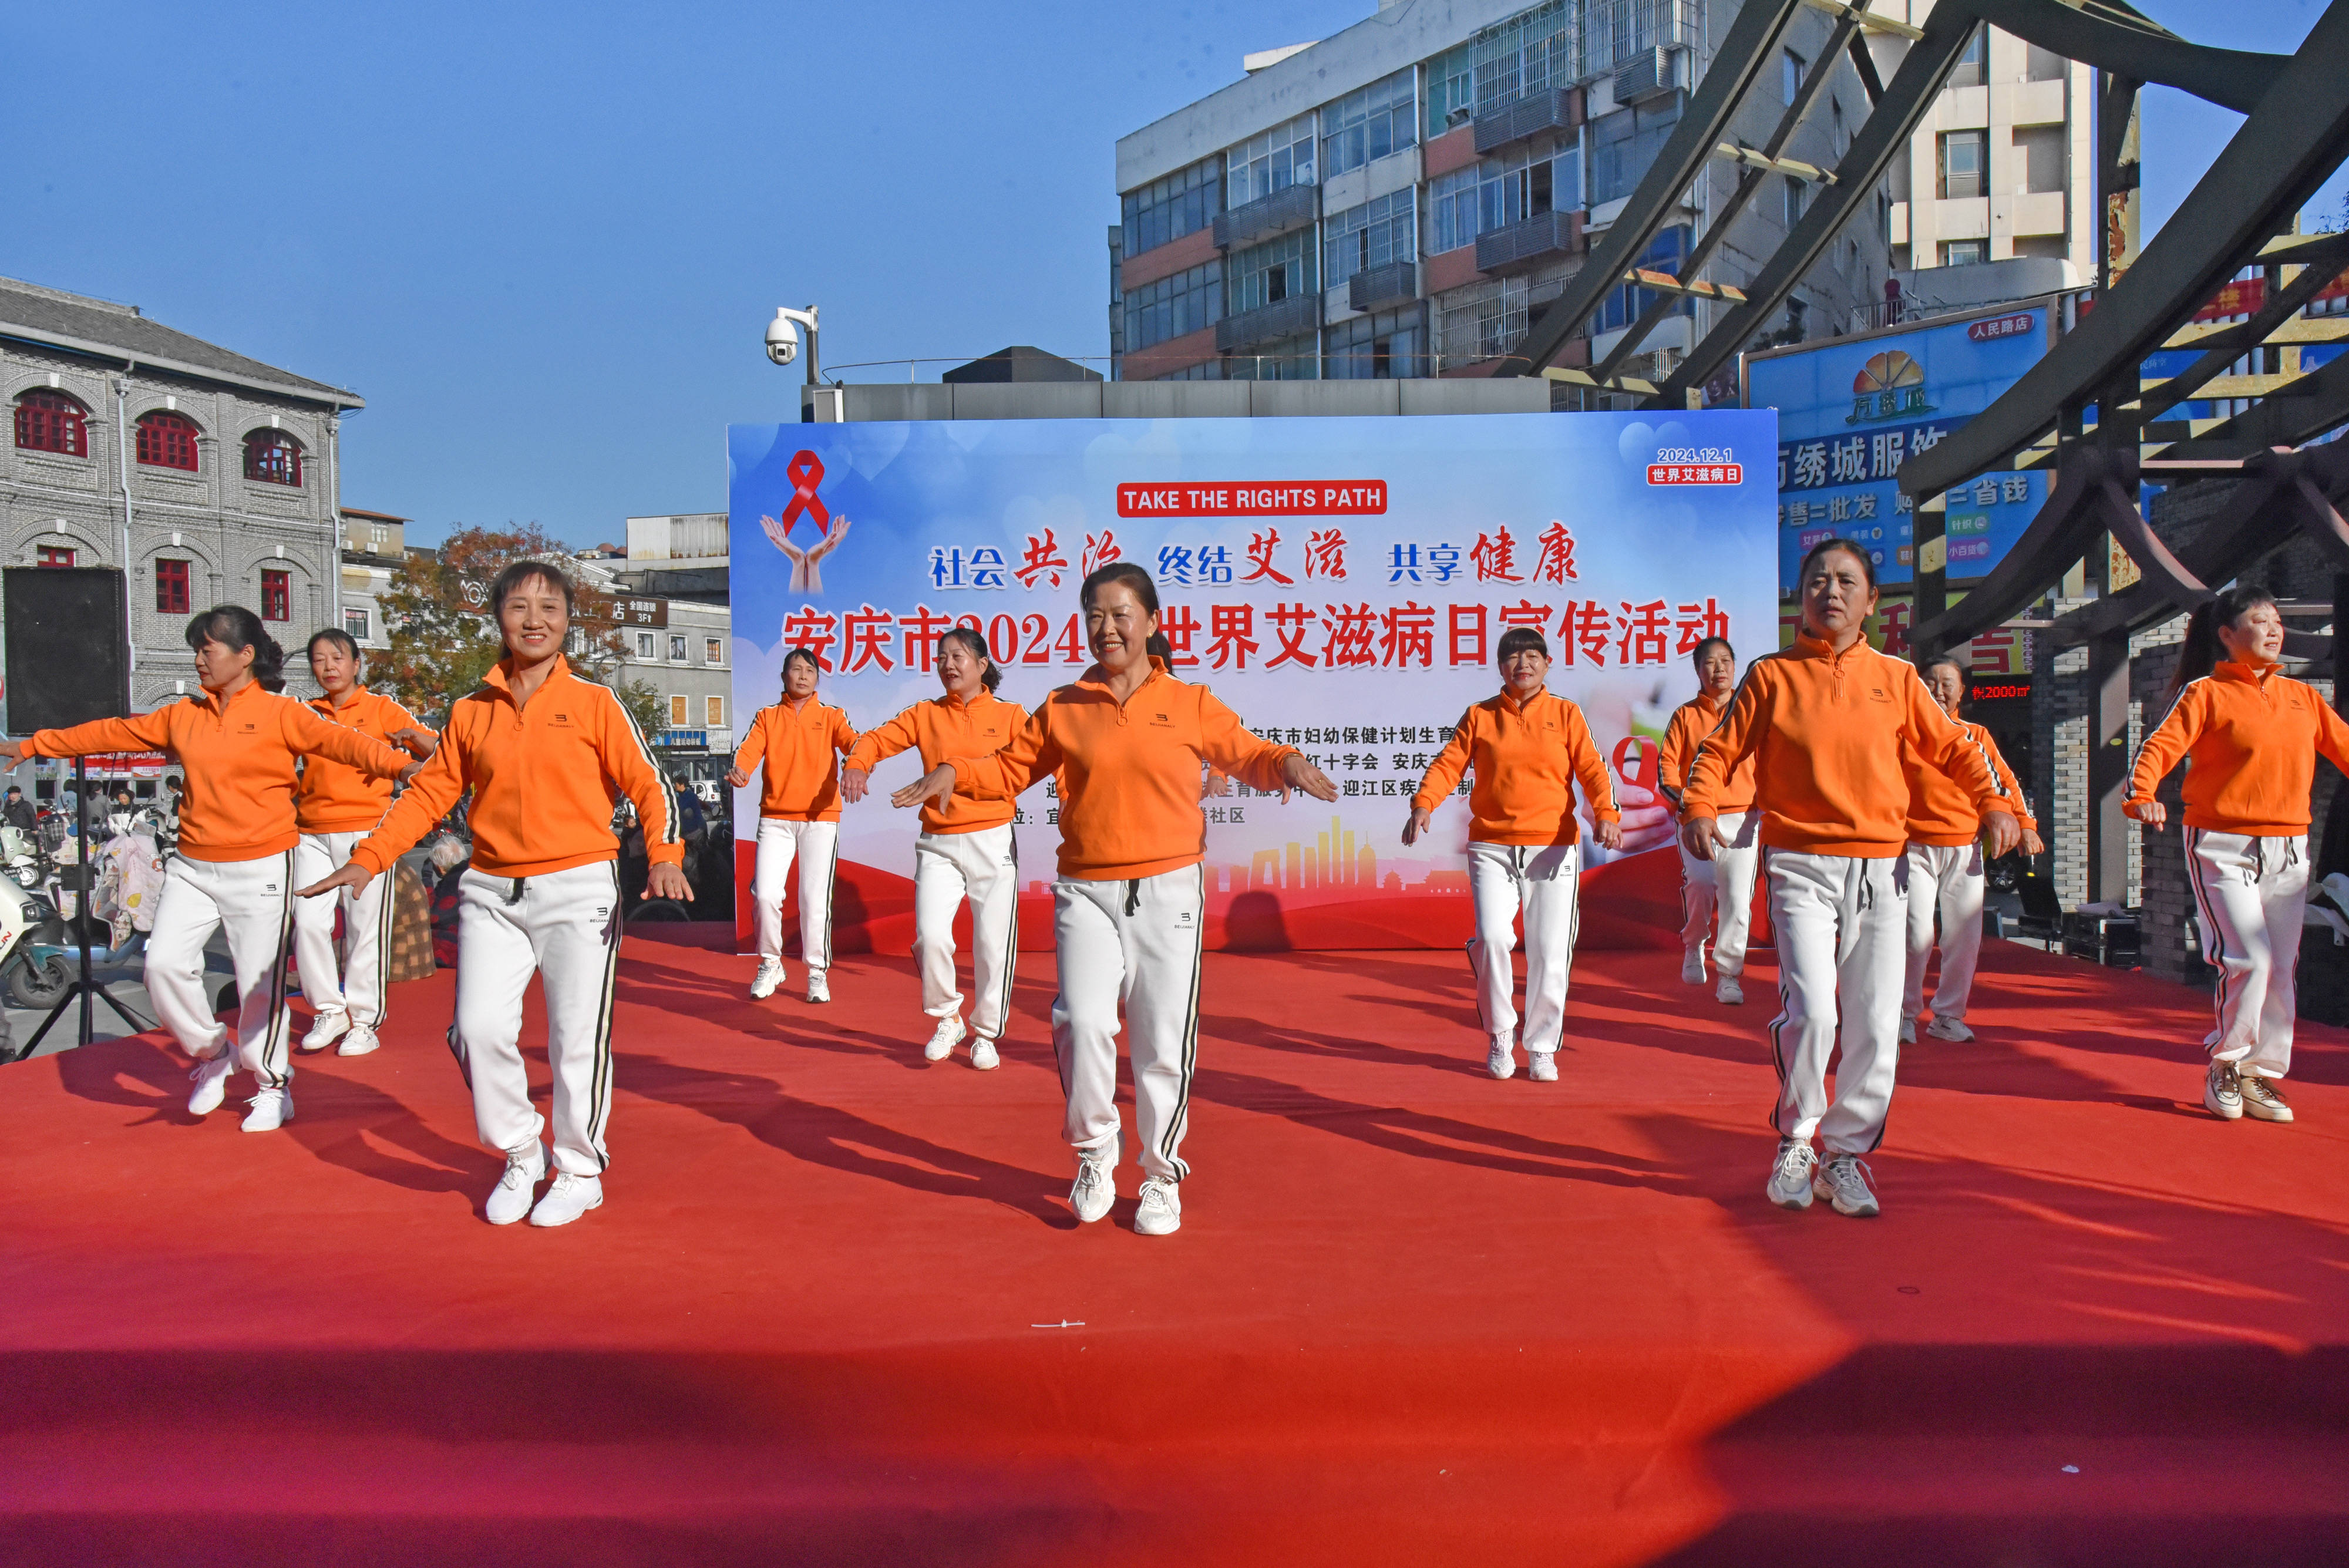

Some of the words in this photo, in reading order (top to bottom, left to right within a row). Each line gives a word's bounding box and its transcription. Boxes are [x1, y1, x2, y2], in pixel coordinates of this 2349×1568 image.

[1974, 316, 2028, 339] 人民路店
[1657, 448, 1732, 463] 2024.12.1
[1651, 467, 1738, 482] 世界艾滋病日
[1124, 491, 1180, 509] TAKE
[1187, 489, 1229, 509] THE
[1236, 488, 1317, 508] RIGHTS
[1329, 487, 1381, 507] PATH
[1951, 519, 1972, 531] 针织
[1158, 527, 1348, 586] 终结艾滋
[1388, 522, 1578, 586] 共享健康
[1948, 544, 1978, 556] 小百货
[629, 600, 657, 613] 全国连锁
[637, 613, 648, 623] 3F
[785, 598, 1729, 673] 安庆市024世界艾滋病日传活动
[1342, 779, 1474, 796] 迎江区疾制
